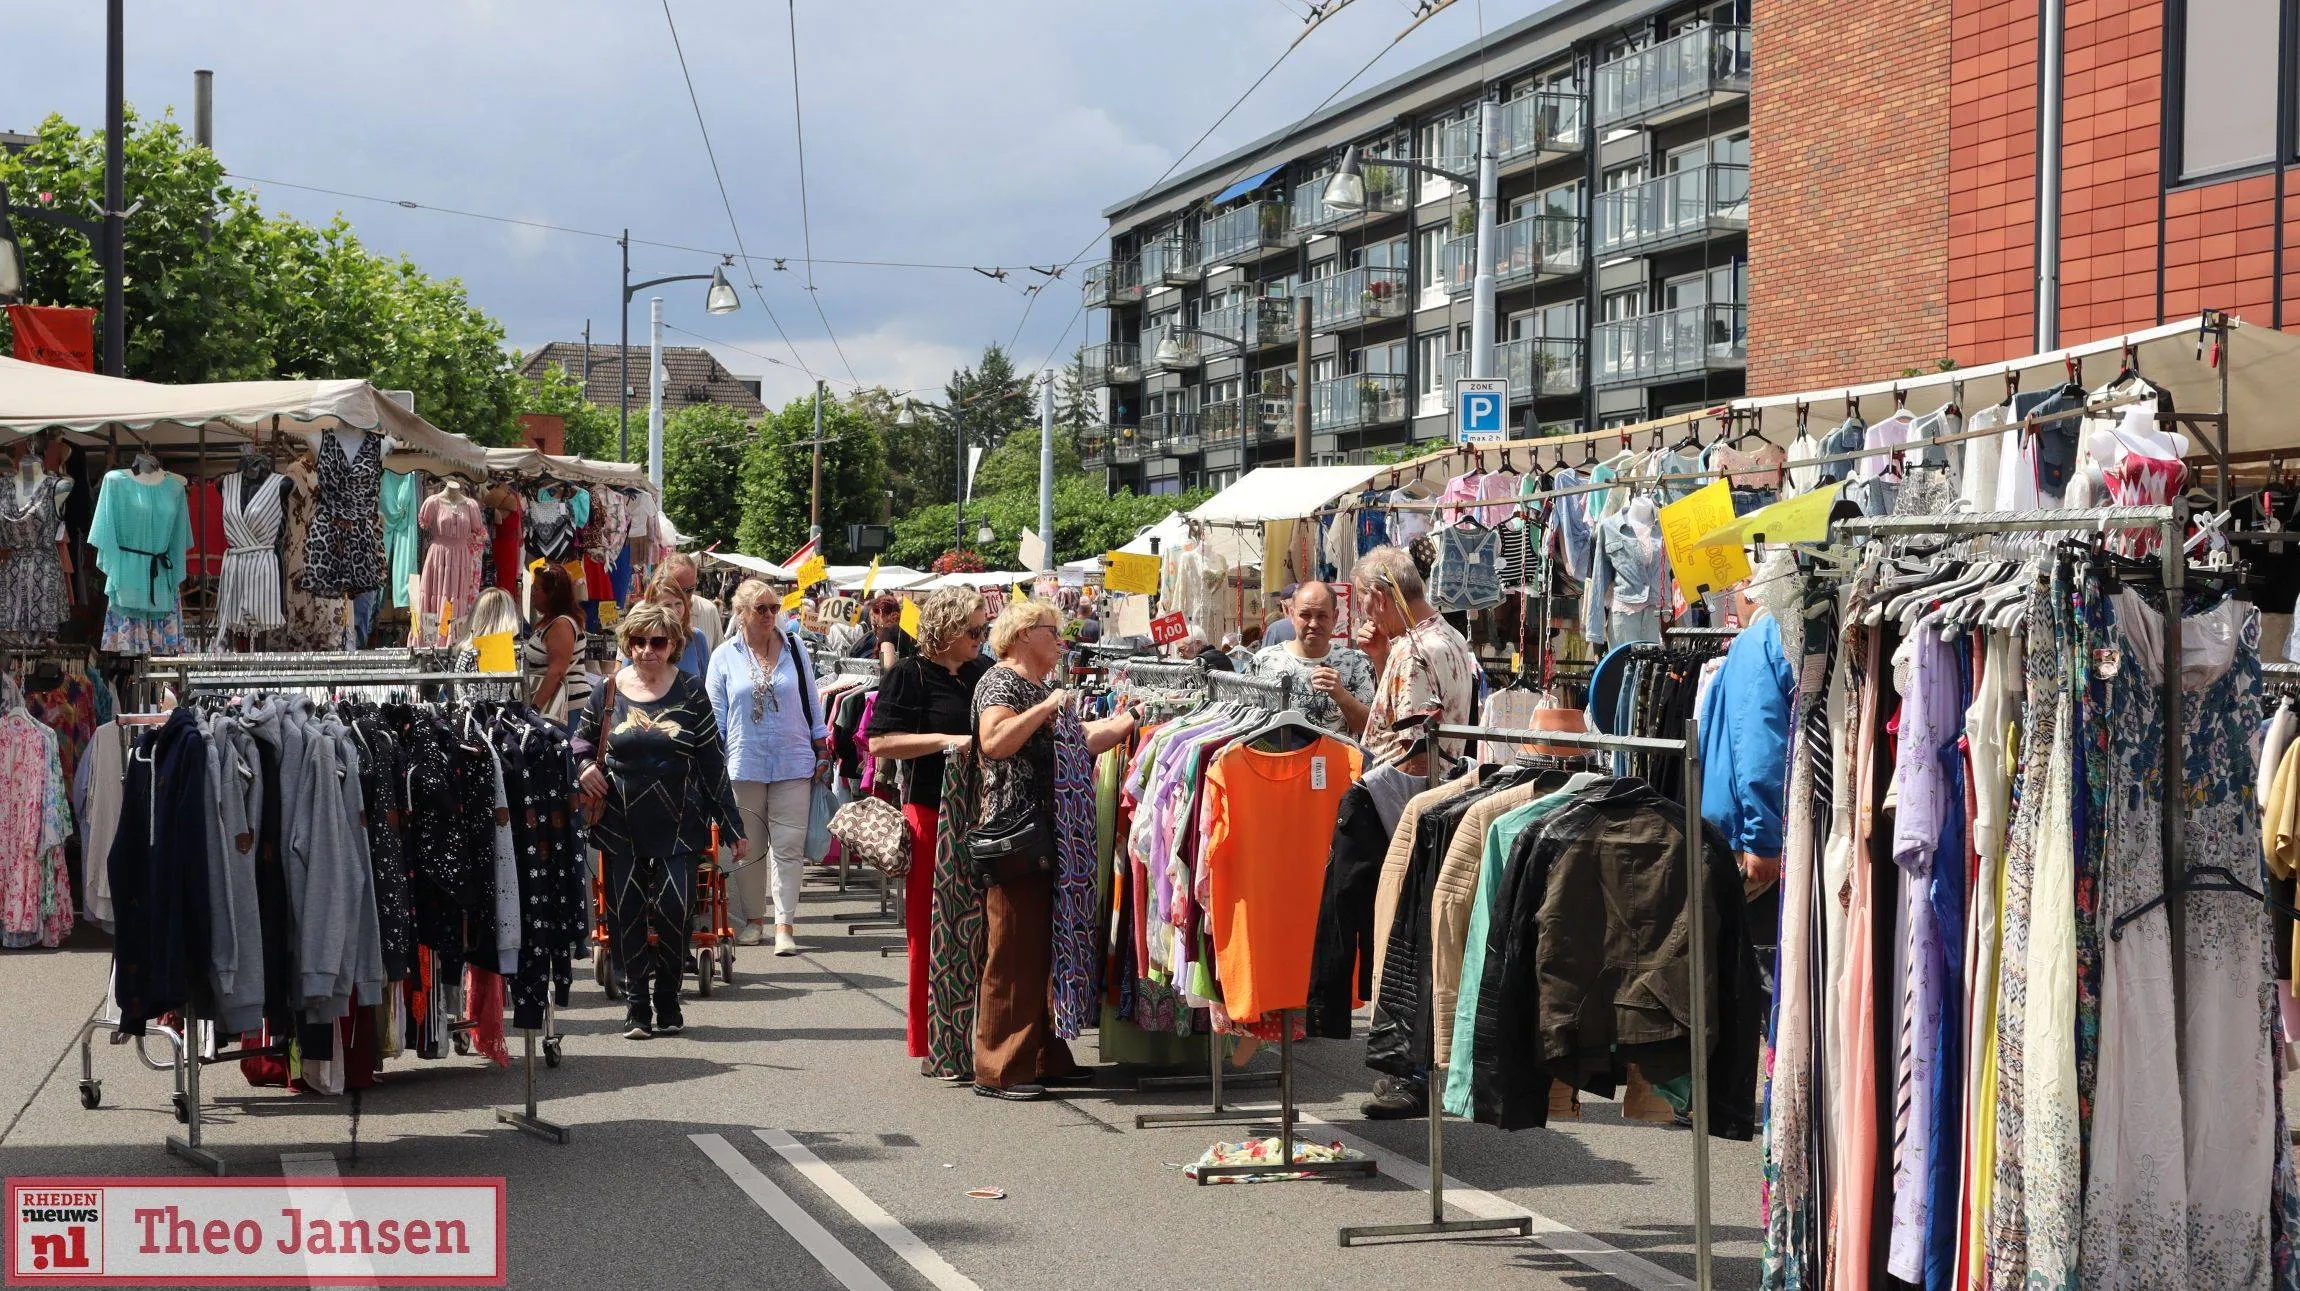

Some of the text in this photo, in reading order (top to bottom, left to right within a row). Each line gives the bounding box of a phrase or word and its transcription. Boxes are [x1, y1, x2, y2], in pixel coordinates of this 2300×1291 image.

[1470, 383, 1494, 391] ZONE
[1470, 397, 1493, 428] P
[1488, 434, 1493, 442] 2
[1495, 434, 1501, 442] h
[1154, 623, 1183, 641] 7,00
